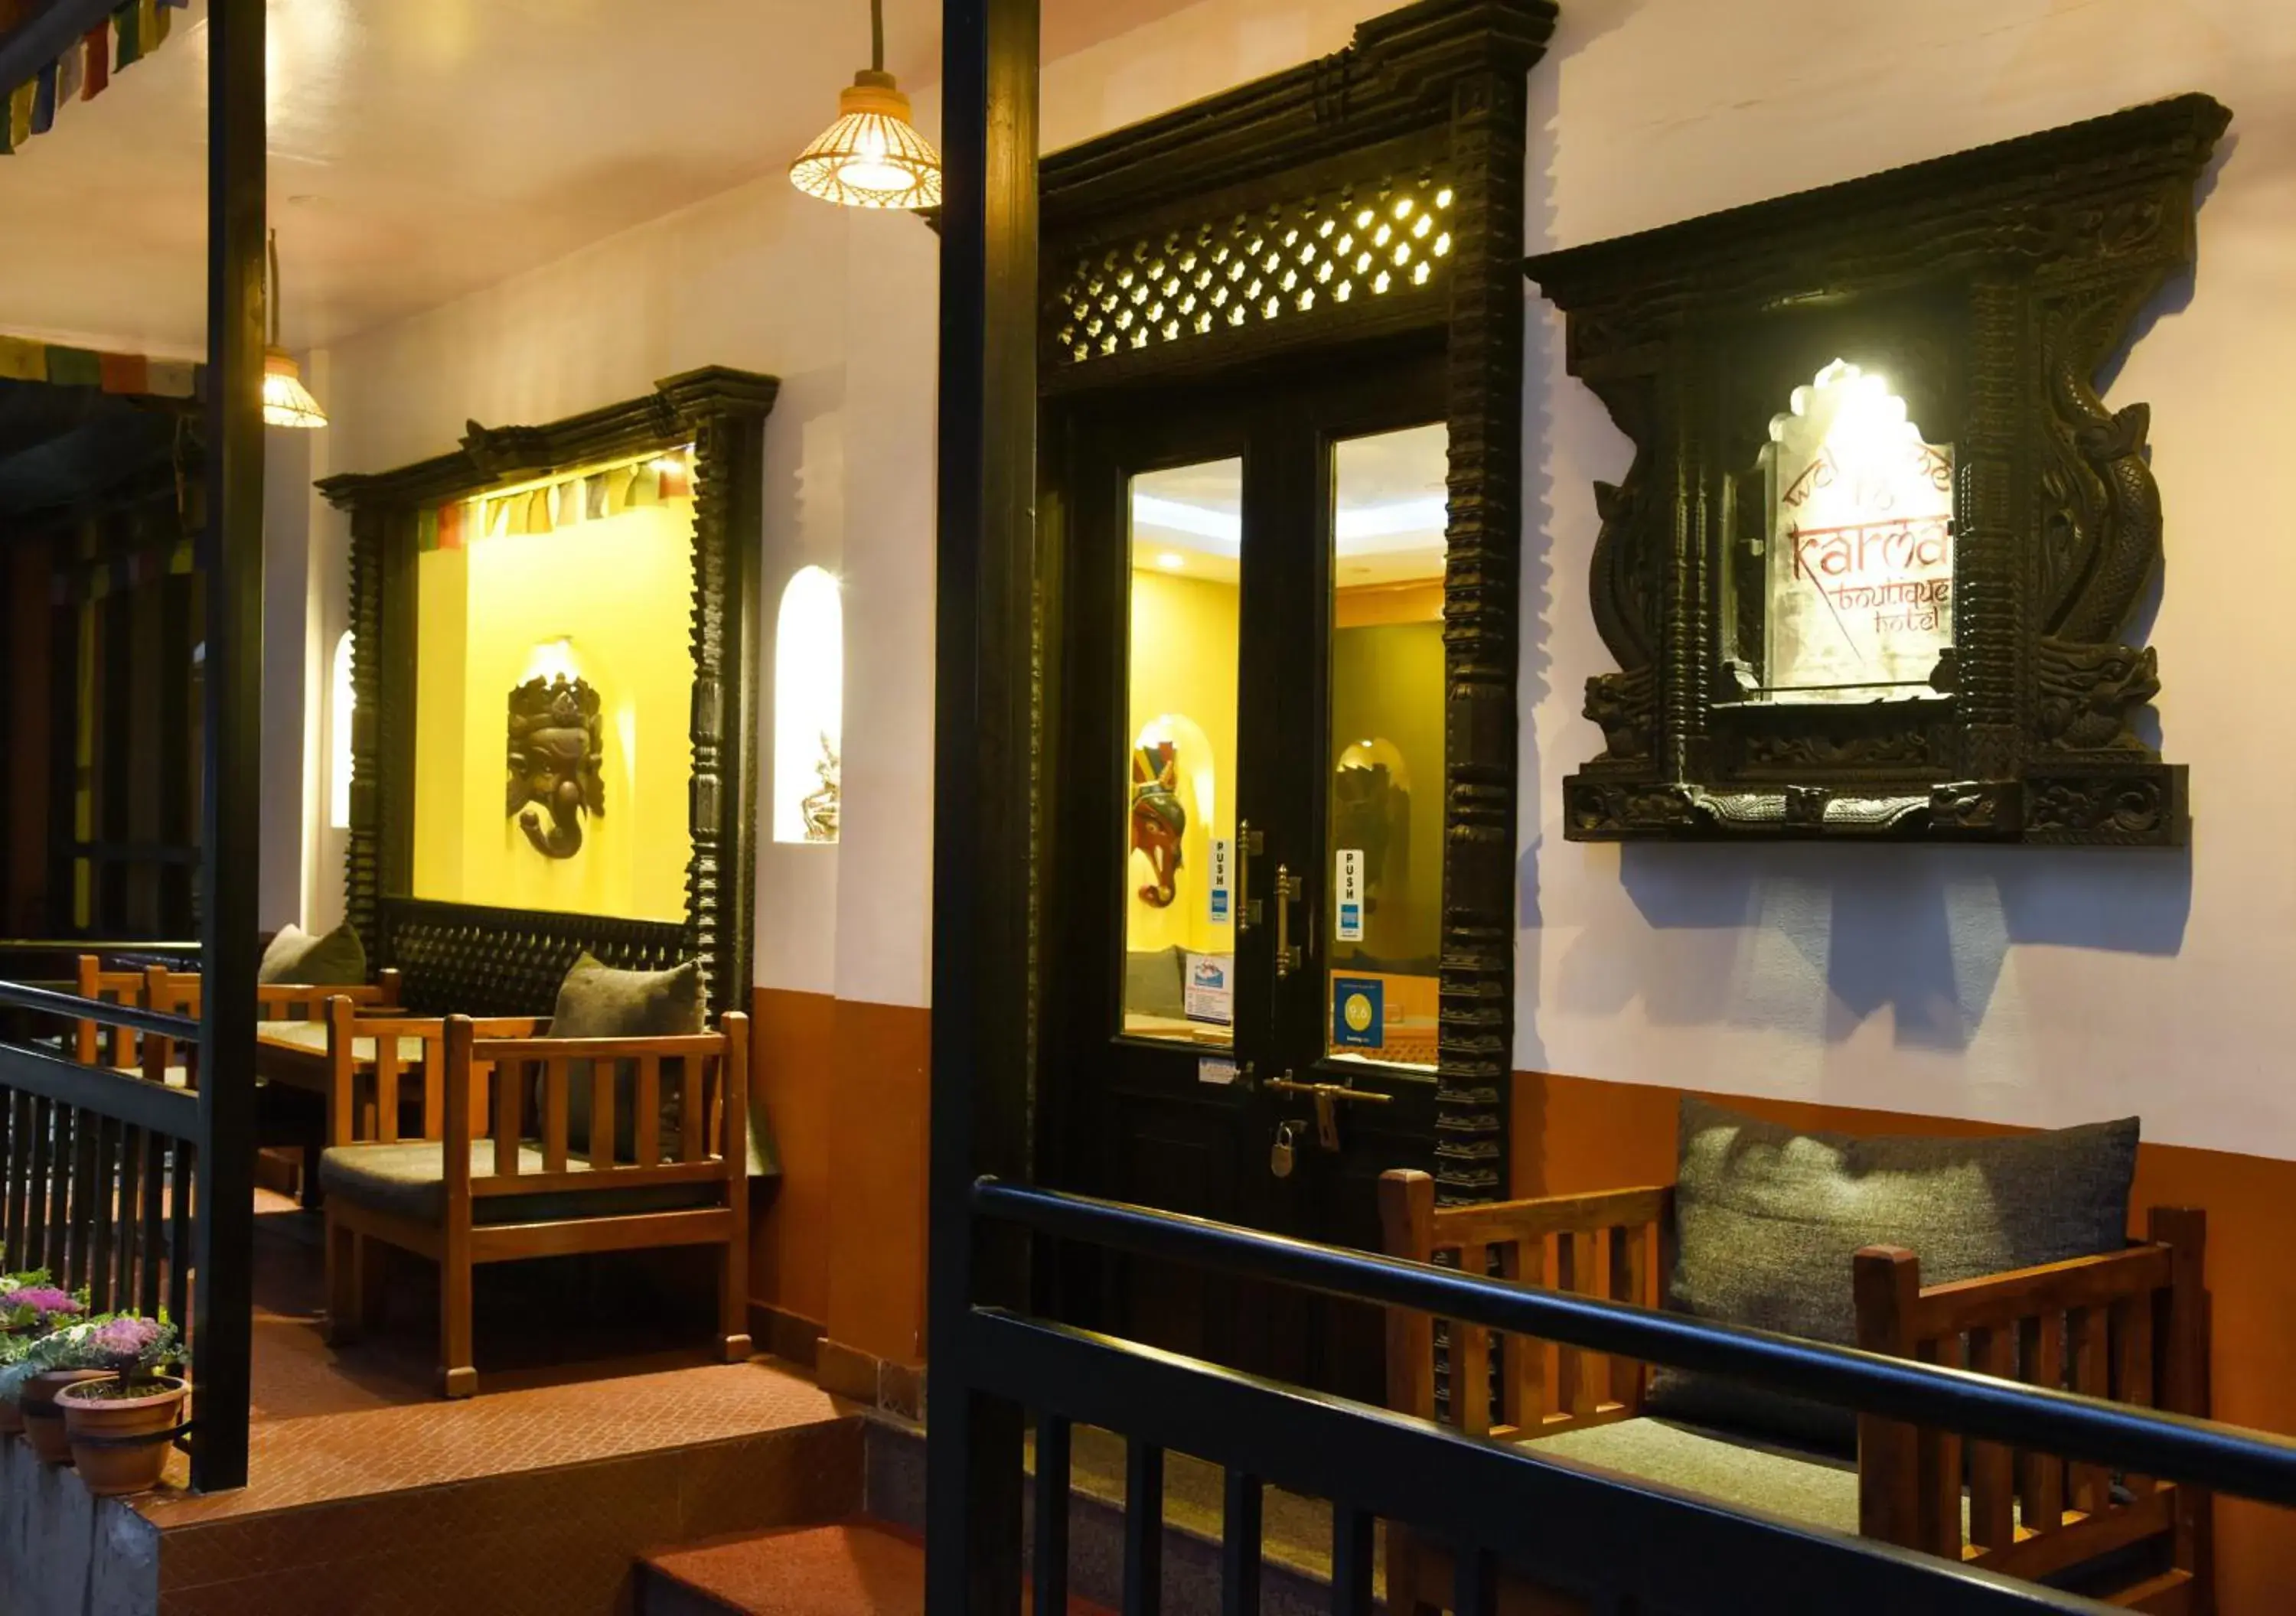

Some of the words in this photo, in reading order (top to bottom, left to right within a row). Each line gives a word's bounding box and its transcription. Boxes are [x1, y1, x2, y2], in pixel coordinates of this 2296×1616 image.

[1828, 578, 1951, 611] boutique
[1874, 607, 1939, 634] hotel
[1349, 1004, 1368, 1020] 9.6
